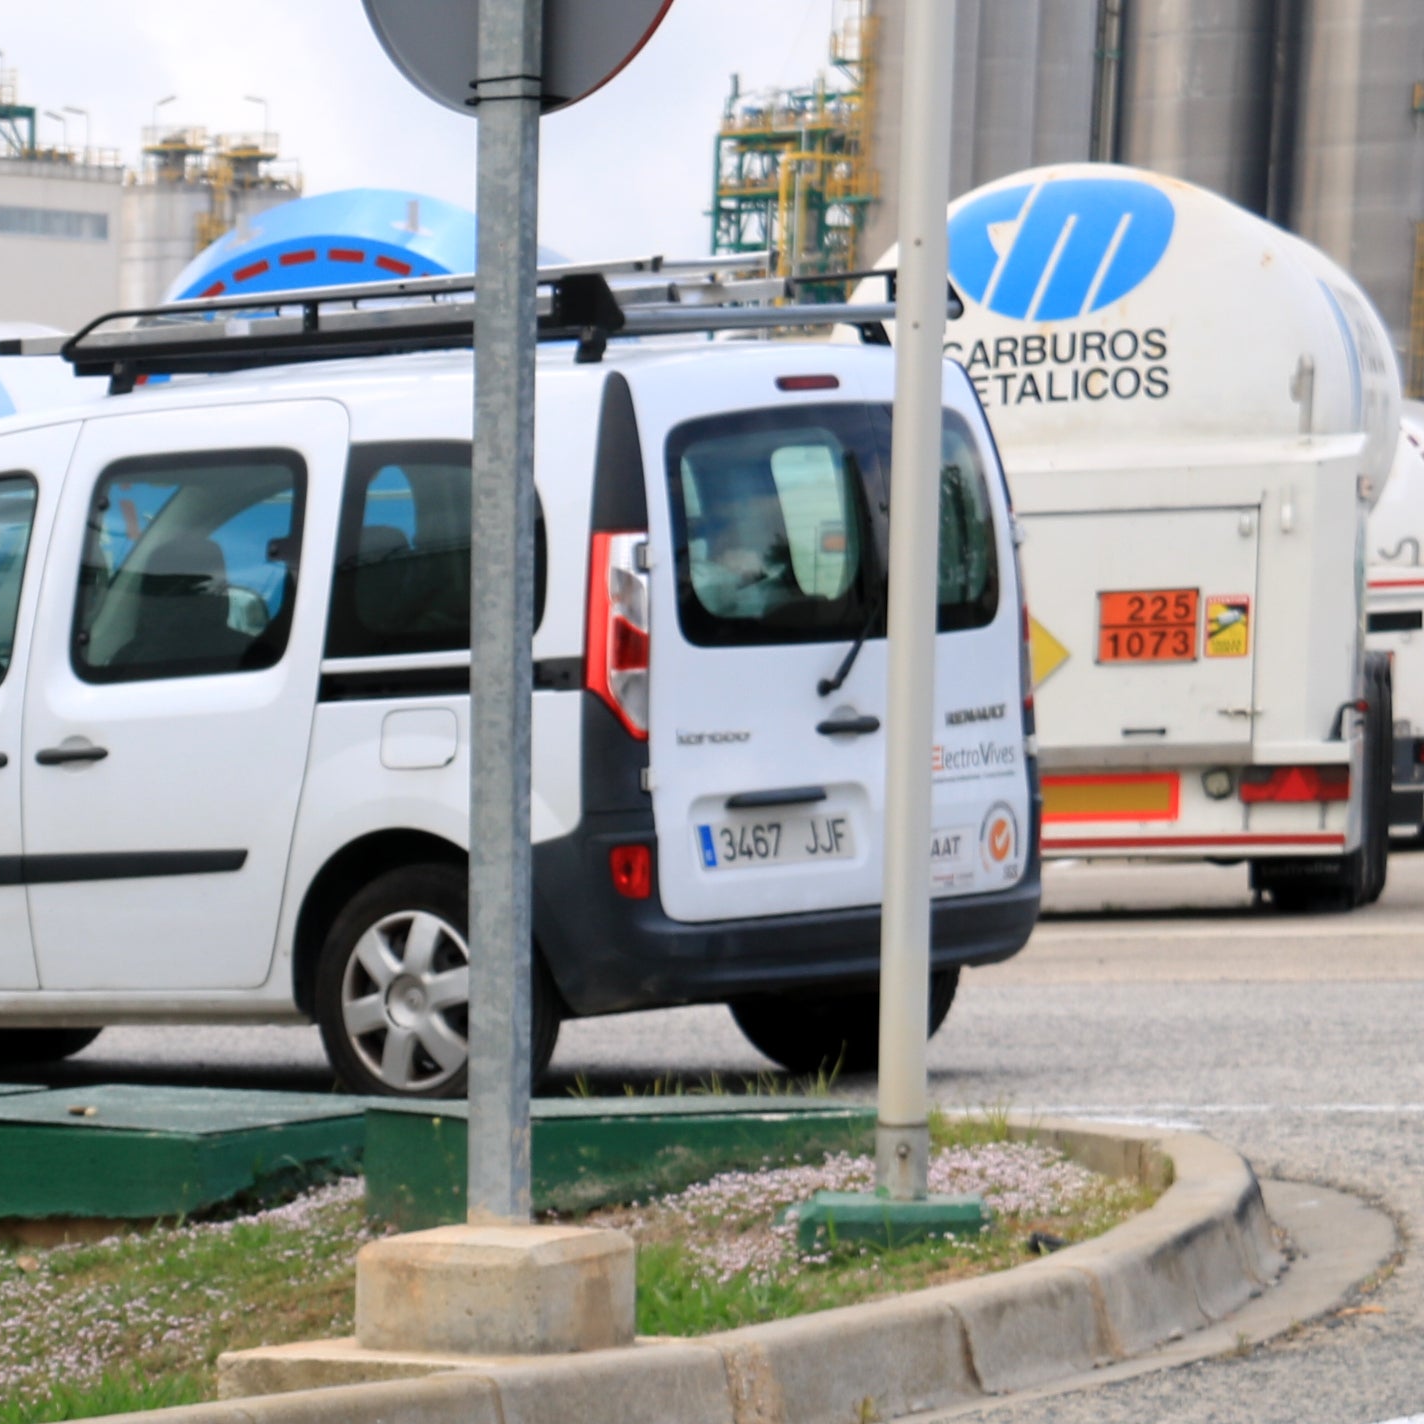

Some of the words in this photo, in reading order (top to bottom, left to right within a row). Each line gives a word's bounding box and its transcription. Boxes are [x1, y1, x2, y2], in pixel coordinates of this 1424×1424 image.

[970, 366, 1169, 408] ETALICOS
[1127, 594, 1191, 622] 225
[1108, 630, 1190, 659] 1073
[720, 822, 782, 862] 3467
[805, 818, 846, 854] JJF
